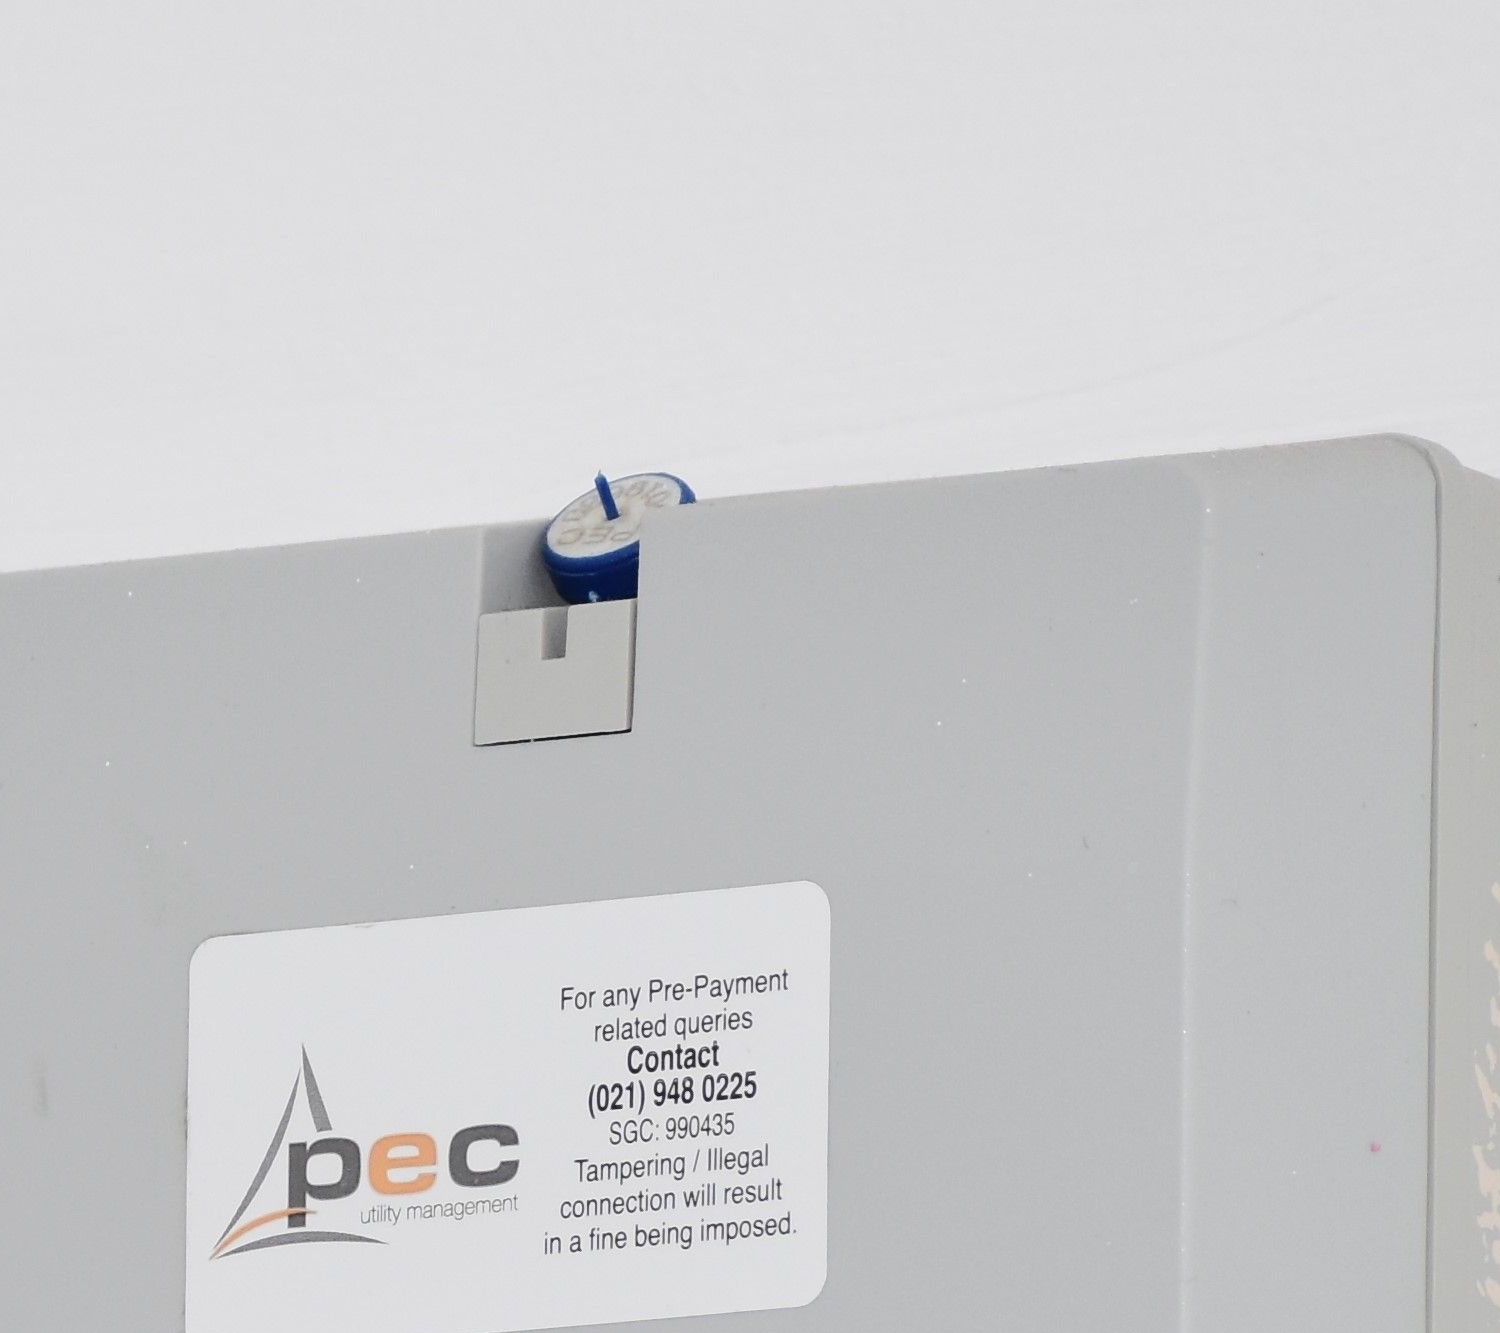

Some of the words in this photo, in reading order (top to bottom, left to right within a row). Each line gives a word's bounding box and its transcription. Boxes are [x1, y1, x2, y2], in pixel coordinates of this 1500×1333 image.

[560, 987, 596, 1011] For
[602, 986, 641, 1011] any
[649, 969, 789, 1003] Pre-Payment
[594, 1013, 667, 1042] related
[674, 1008, 753, 1040] queries
[627, 1041, 720, 1074] Contact
[588, 1079, 646, 1118] (021)
[653, 1077, 694, 1107] 948
[702, 1071, 758, 1102] 0225
[609, 1119, 660, 1145] SGC:
[666, 1112, 735, 1140] 990435
[287, 1123, 520, 1229] pec
[574, 1153, 686, 1185] Tampering
[692, 1150, 700, 1173] /
[707, 1143, 769, 1175] Illegal
[360, 1204, 401, 1226] utility
[406, 1194, 519, 1221] management
[560, 1189, 675, 1219] connection
[683, 1182, 716, 1208] will
[723, 1178, 783, 1204] result
[544, 1232, 561, 1255] in
[569, 1234, 582, 1252] a
[590, 1227, 627, 1251] fine
[634, 1221, 693, 1250] being
[700, 1212, 797, 1244] imposed.
